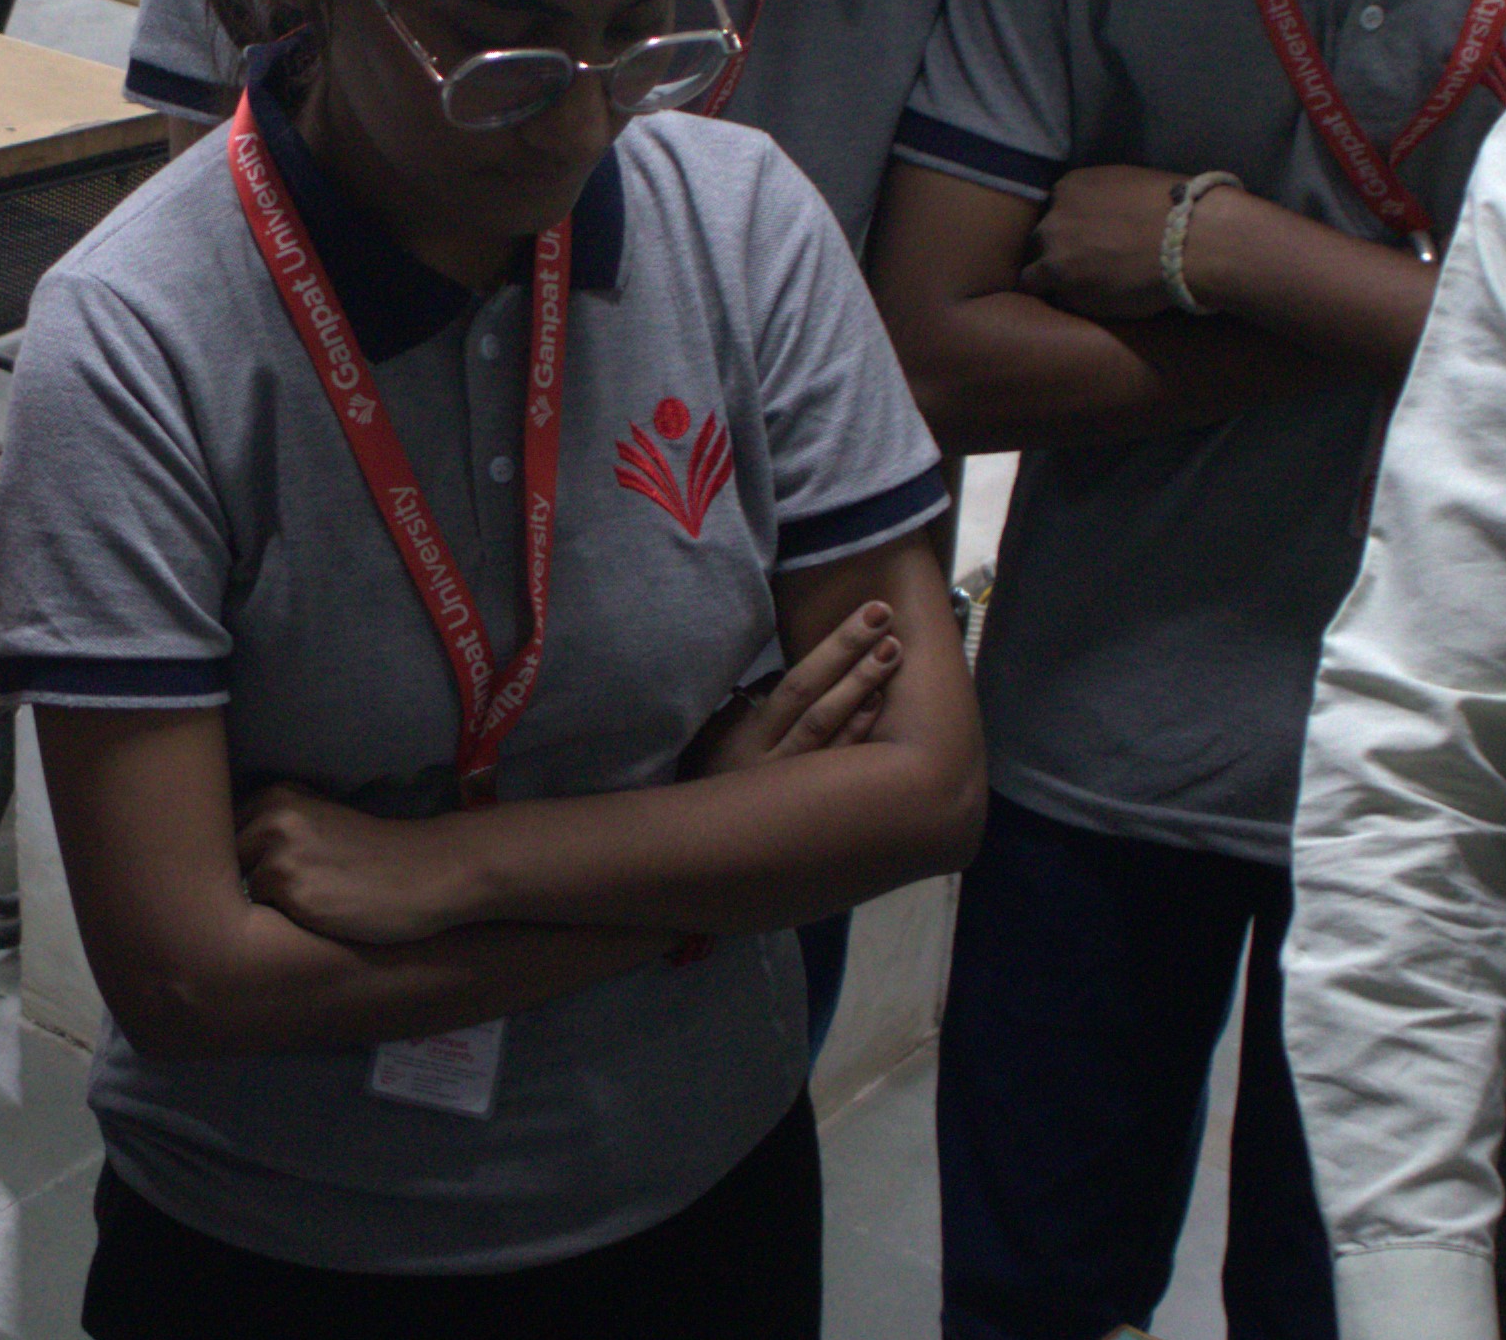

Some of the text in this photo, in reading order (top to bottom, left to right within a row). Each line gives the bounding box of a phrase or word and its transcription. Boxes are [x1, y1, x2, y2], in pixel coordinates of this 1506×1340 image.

[1321, 110, 1388, 198] Ganpat
[234, 132, 361, 391] Ganpat University
[533, 269, 562, 390] Ganpat
[389, 484, 471, 634] University
